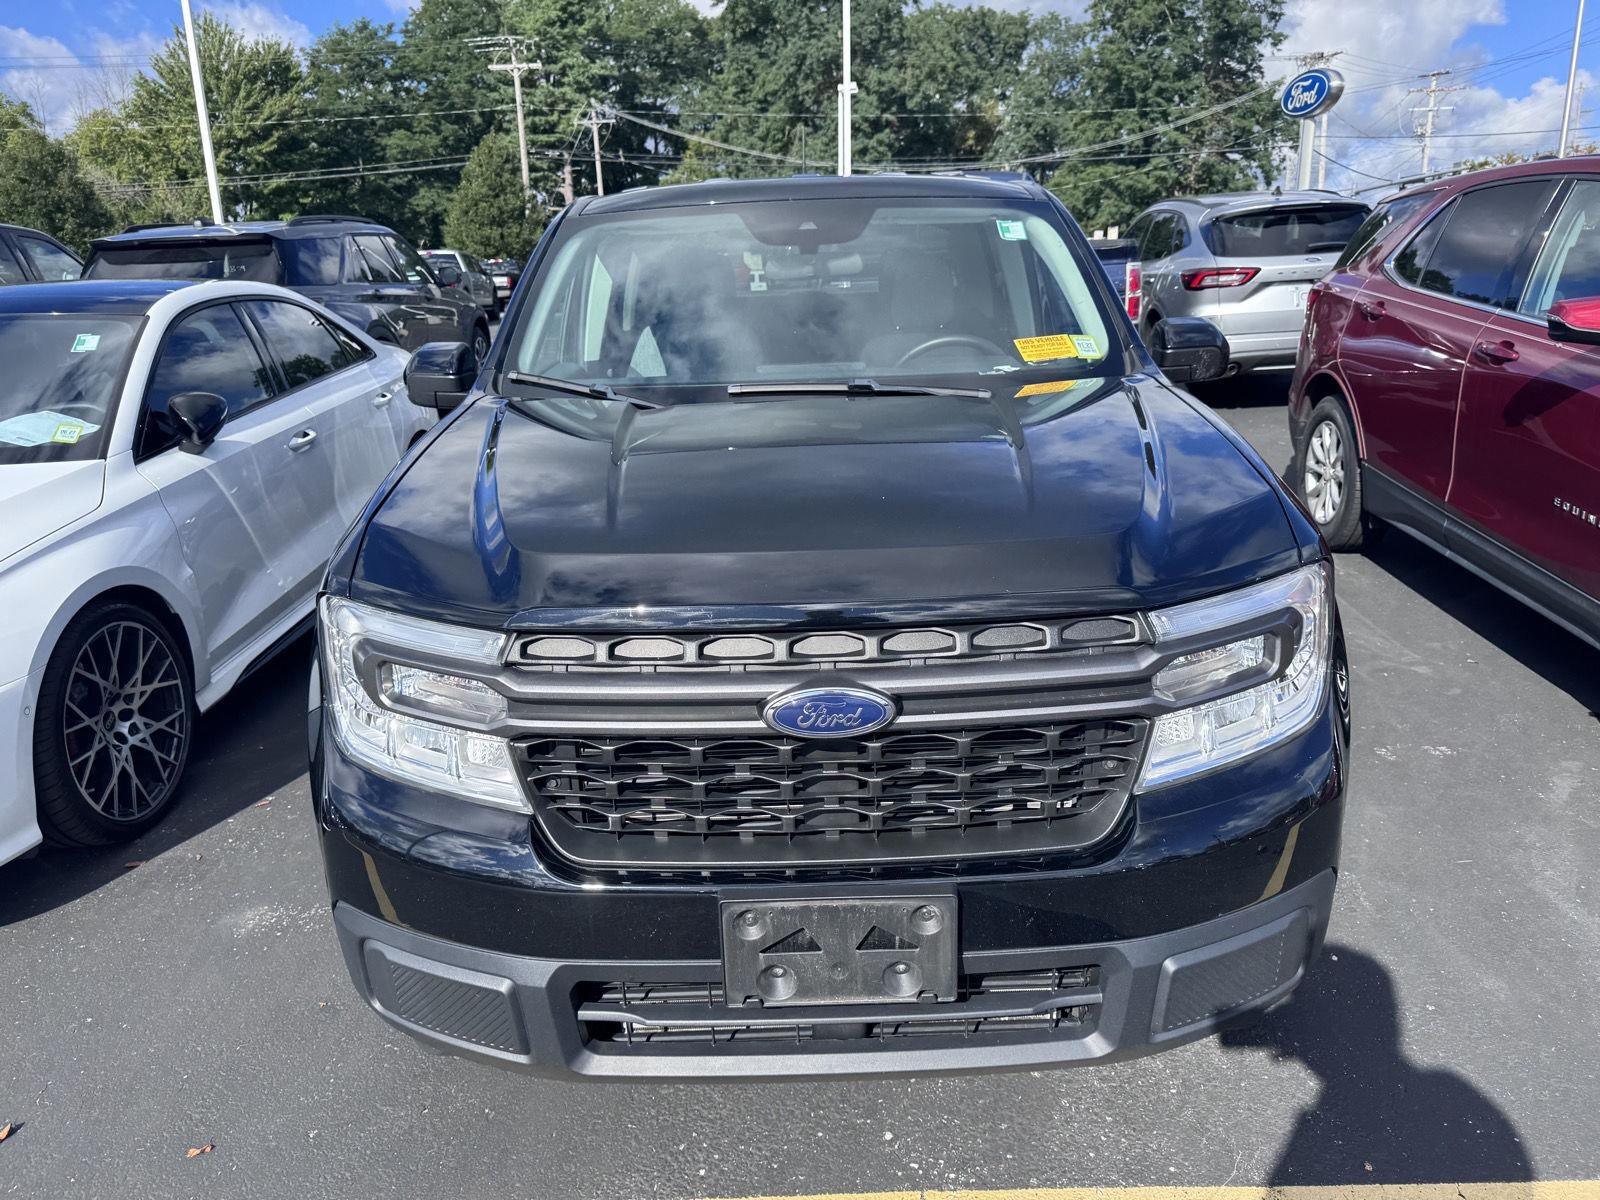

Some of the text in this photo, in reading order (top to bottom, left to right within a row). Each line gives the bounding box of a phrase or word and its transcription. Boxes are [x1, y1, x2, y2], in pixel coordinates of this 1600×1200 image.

[1287, 79, 1319, 110] Ford
[1018, 338, 1034, 346] THIS
[1035, 336, 1065, 344] VEHICLE
[796, 701, 863, 729] Ford
